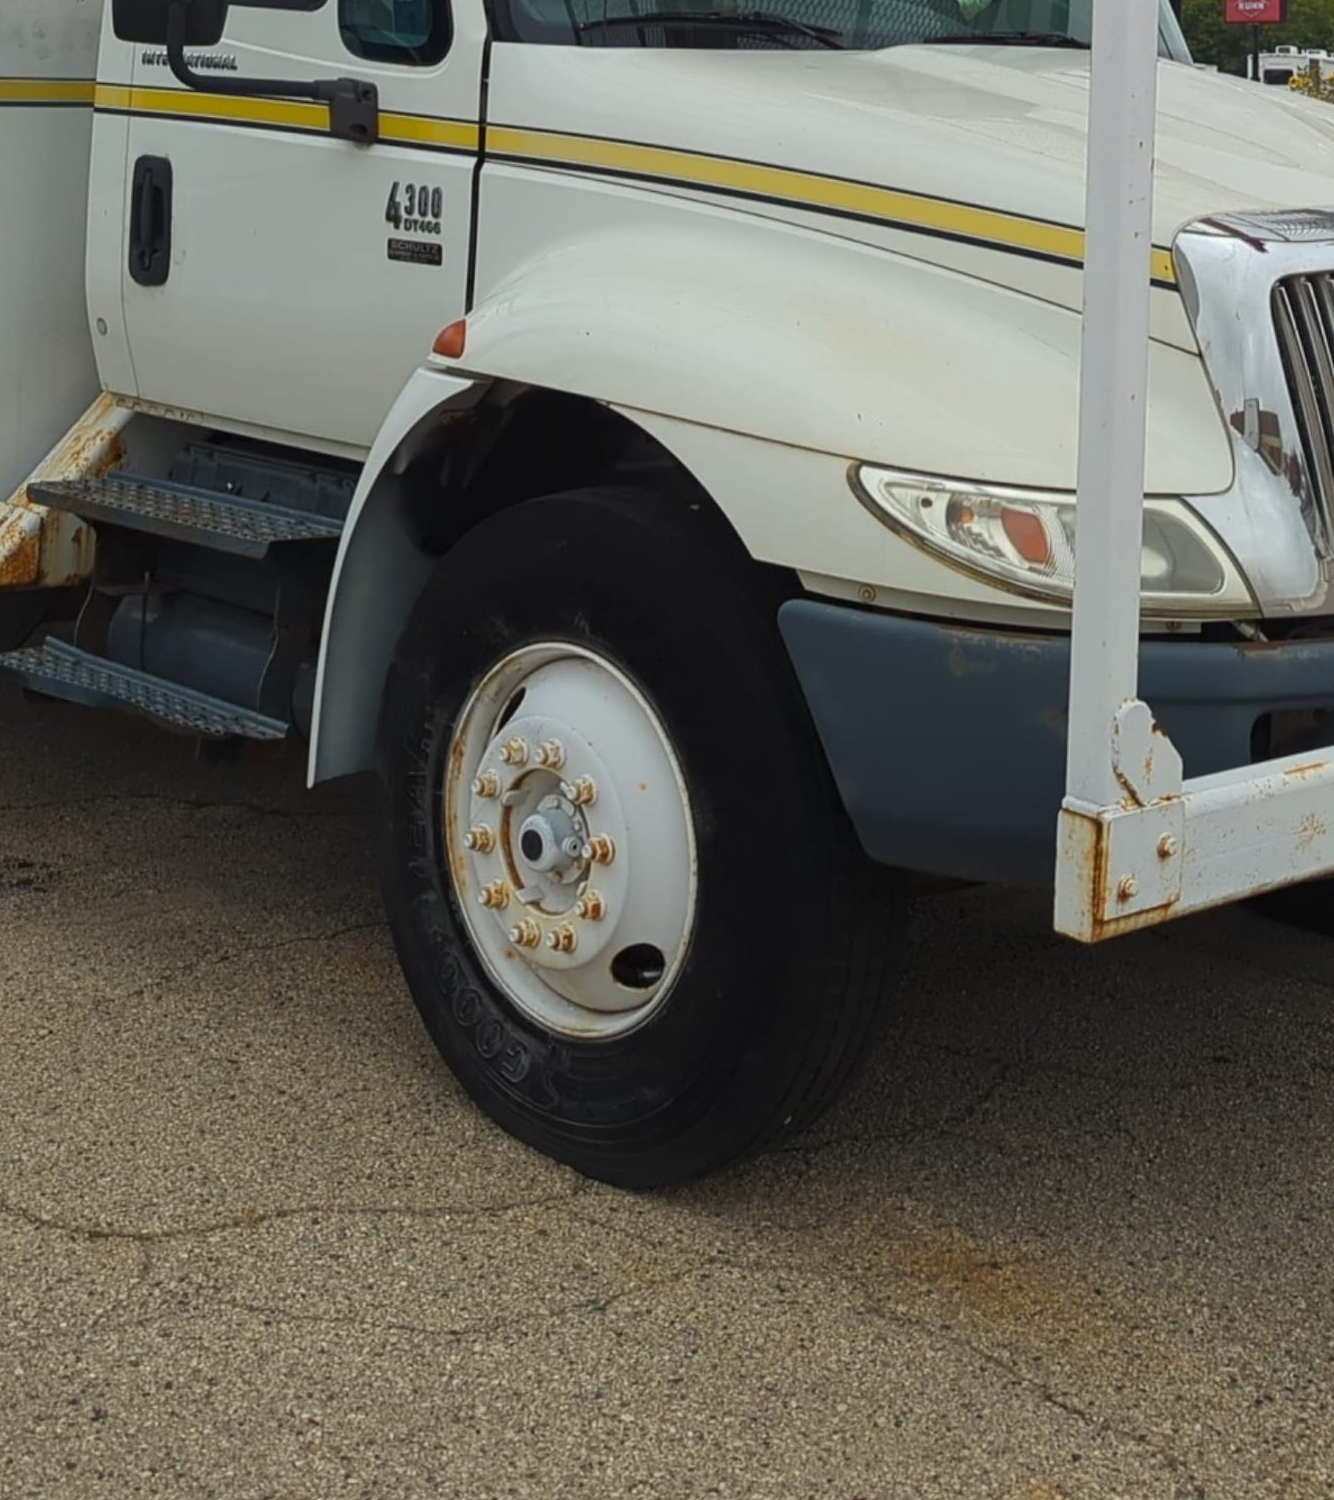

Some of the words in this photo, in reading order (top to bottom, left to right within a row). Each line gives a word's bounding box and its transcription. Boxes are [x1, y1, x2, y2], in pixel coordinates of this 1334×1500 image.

[141, 51, 238, 71] INTEATIONAL
[385, 181, 443, 230] 4300
[404, 218, 442, 235] DT466
